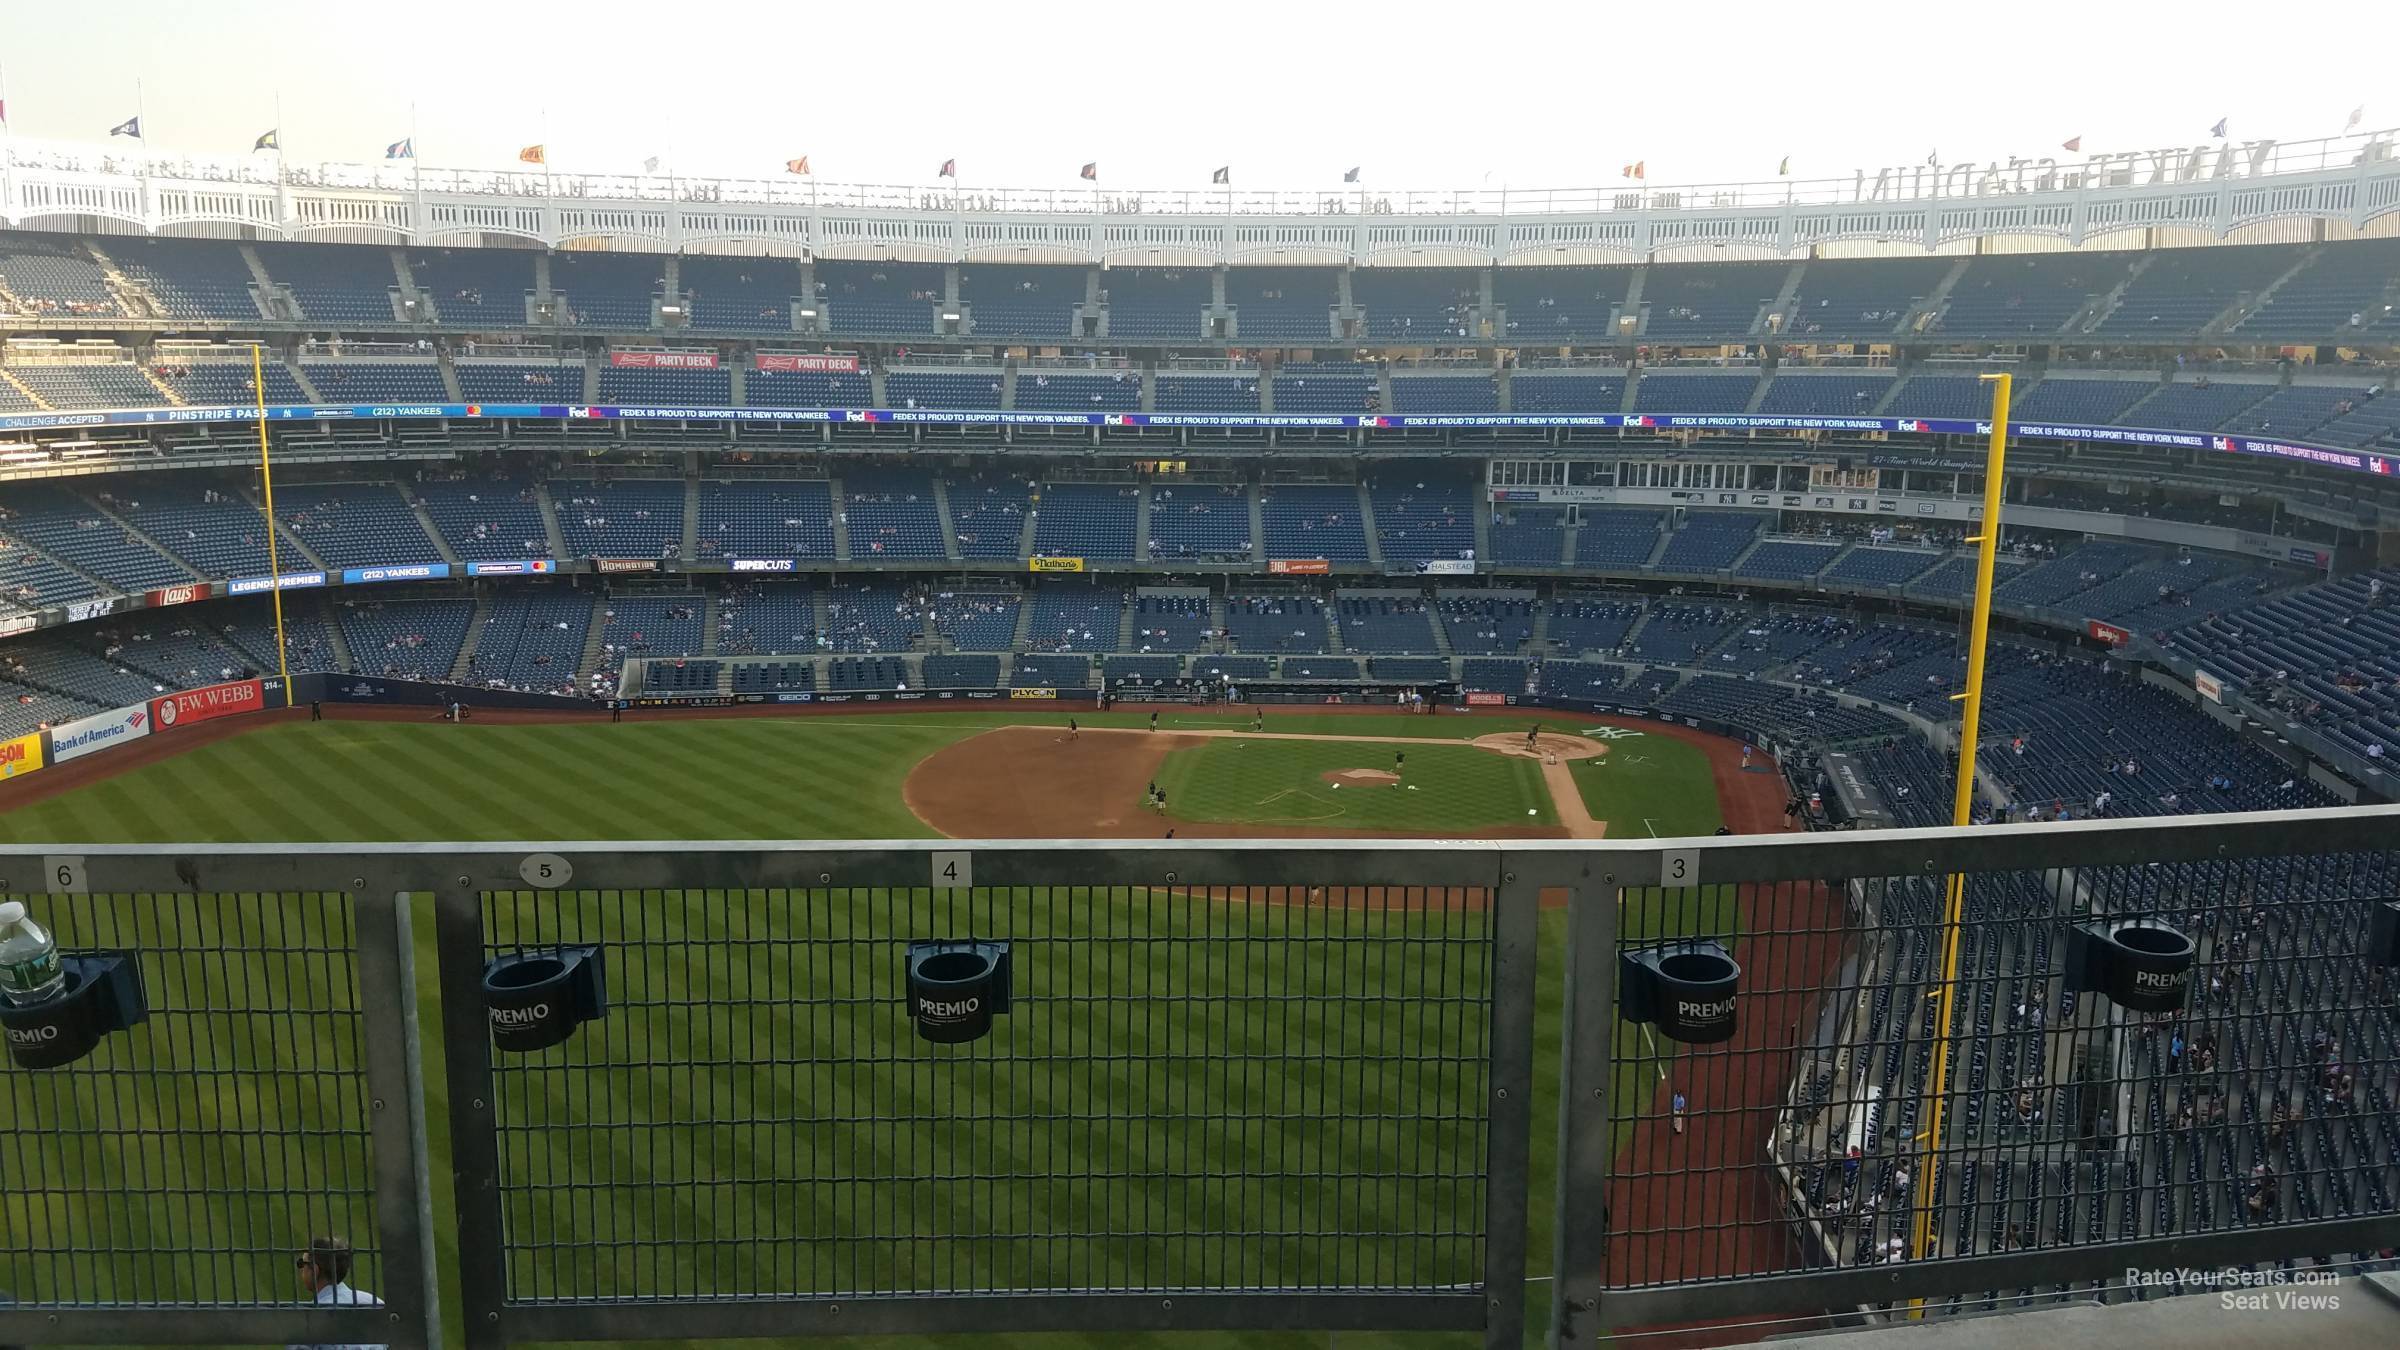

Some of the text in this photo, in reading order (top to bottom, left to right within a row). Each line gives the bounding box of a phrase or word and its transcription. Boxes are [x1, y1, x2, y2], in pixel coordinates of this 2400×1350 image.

[655, 355, 684, 367] PARTY
[687, 356, 712, 367] DECK
[798, 358, 827, 369] PARTY
[828, 358, 853, 370] DECK
[170, 408, 269, 421] PINSTRIPE PASS
[314, 408, 354, 416] yankees.com
[372, 406, 442, 416] (212) YANKEES
[620, 409, 831, 419] FEDEX IS PROUD TO SUPPORT THE NEW YORK YANKEES.
[6, 414, 104, 428] CHALLENGE ACCEPTED
[893, 413, 916, 421] FEDEX
[918, 413, 926, 421] IS
[927, 413, 953, 421] PROUD
[965, 414, 1000, 422] SUPPORT
[1001, 414, 1015, 422] THE
[1034, 415, 1053, 423] YORK
[1053, 415, 1089, 423] YANKEES.
[1150, 416, 1343, 425] FEDEX IS PROUD TO SUPPORT THE NEW YORK YANKEES.
[1404, 417, 1606, 425] FEDEX IS PROUD TO SUPPORT THE NEW YORK YANKEES.
[1672, 417, 1883, 428] FEDEX IS PROUD TO SUPPORT THE NEW YORK YANKEES.
[1976, 422, 1993, 434] Fed
[2020, 426, 2203, 446] FEDEX IS PROUD TO SUPPORT THE NEW YORK YANKEES.
[734, 560, 792, 570] SUPERCUTS
[1270, 561, 1290, 572] JBL
[362, 567, 430, 580] (212) YANKEES
[232, 574, 322, 592] LEGENDS PREMIER
[264, 681, 278, 690] 314
[206, 684, 254, 705] WEBB
[1012, 688, 1054, 696] PLYCON
[54, 723, 125, 754] Bank of America
[539, 864, 552, 878] 5
[943, 860, 958, 881] 4
[1672, 858, 1685, 879] 3
[57, 864, 72, 886] 6
[919, 997, 979, 1016] PREMIO
[1678, 995, 1737, 1018] PREMIO
[489, 1003, 549, 1024] PREMIO
